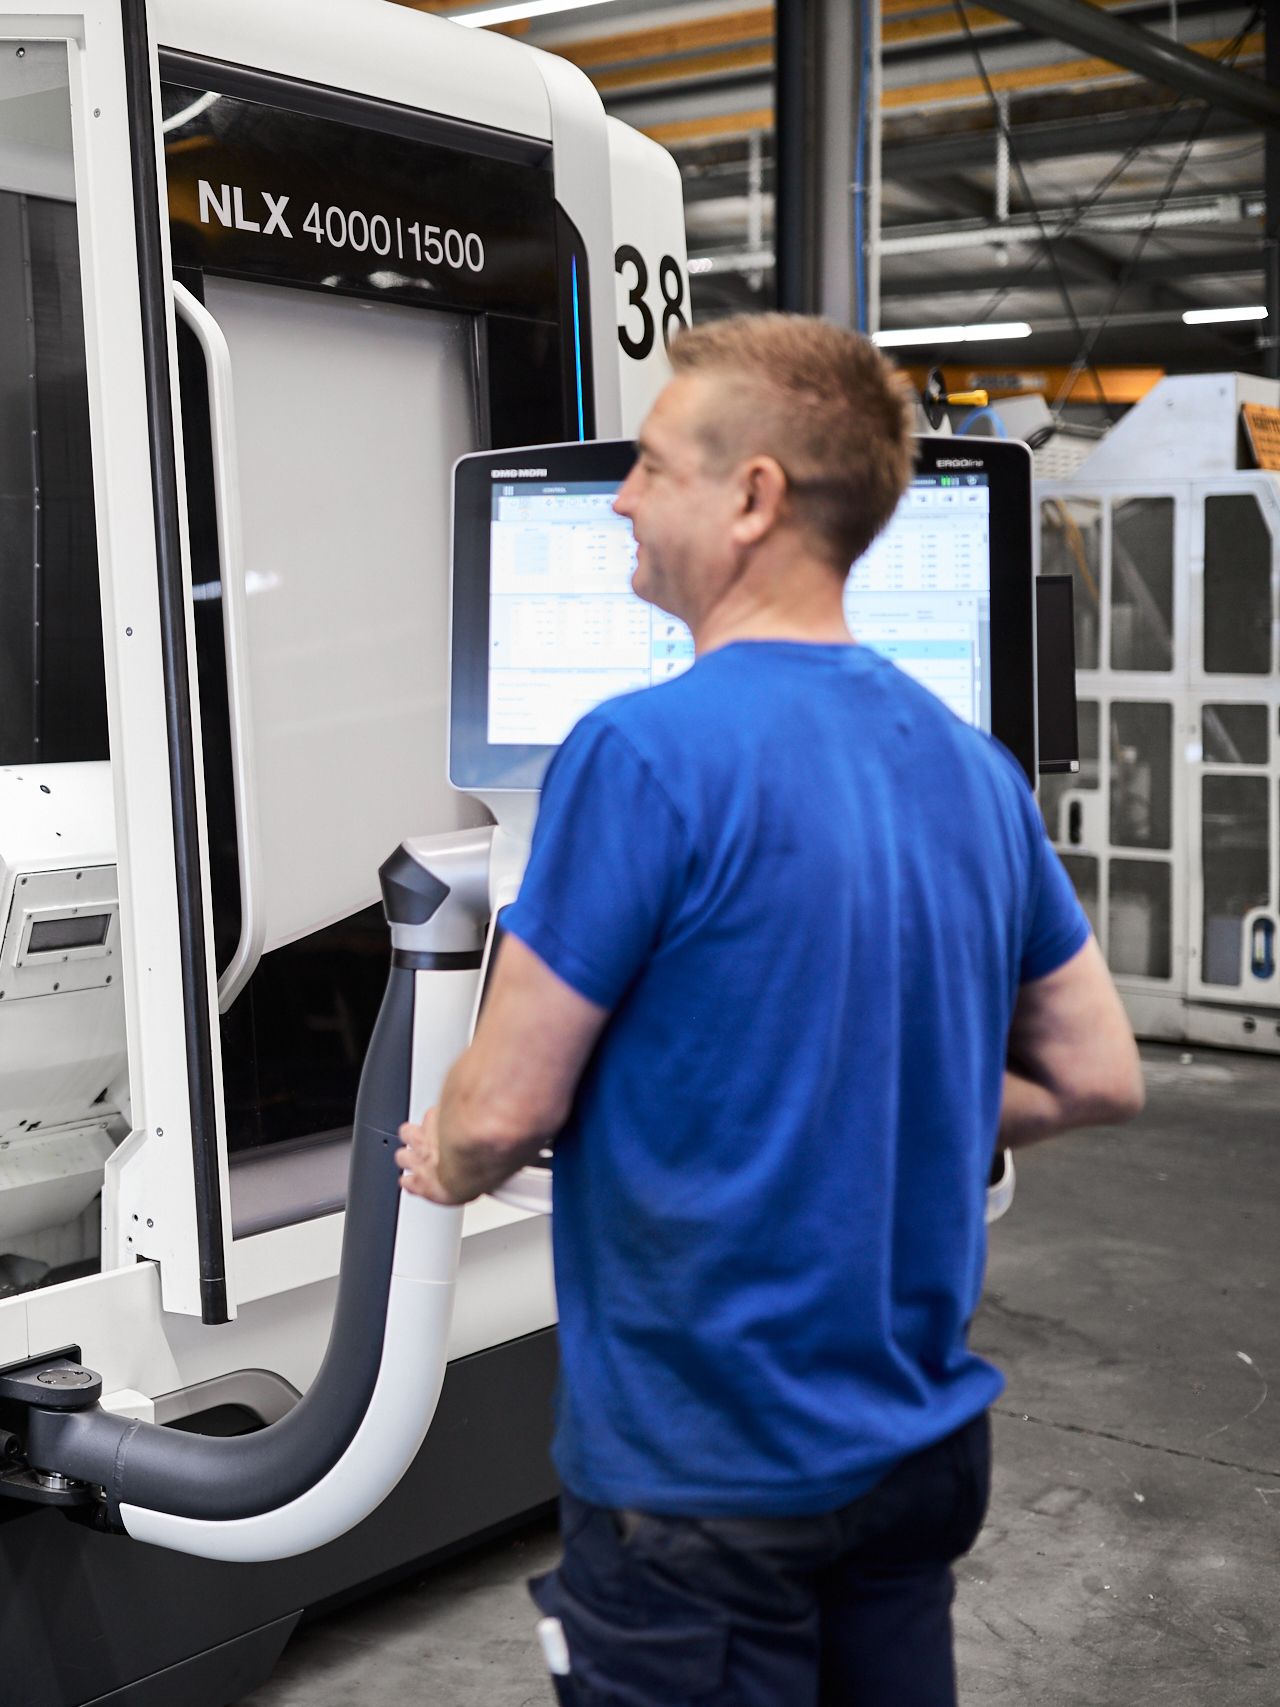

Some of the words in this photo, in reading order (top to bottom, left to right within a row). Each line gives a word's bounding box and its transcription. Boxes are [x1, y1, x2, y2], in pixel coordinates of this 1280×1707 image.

[198, 179, 294, 239] NLX
[614, 244, 689, 360] 38
[491, 469, 518, 478] DMG
[518, 468, 548, 477] MORI
[935, 458, 984, 468] ERGOline
